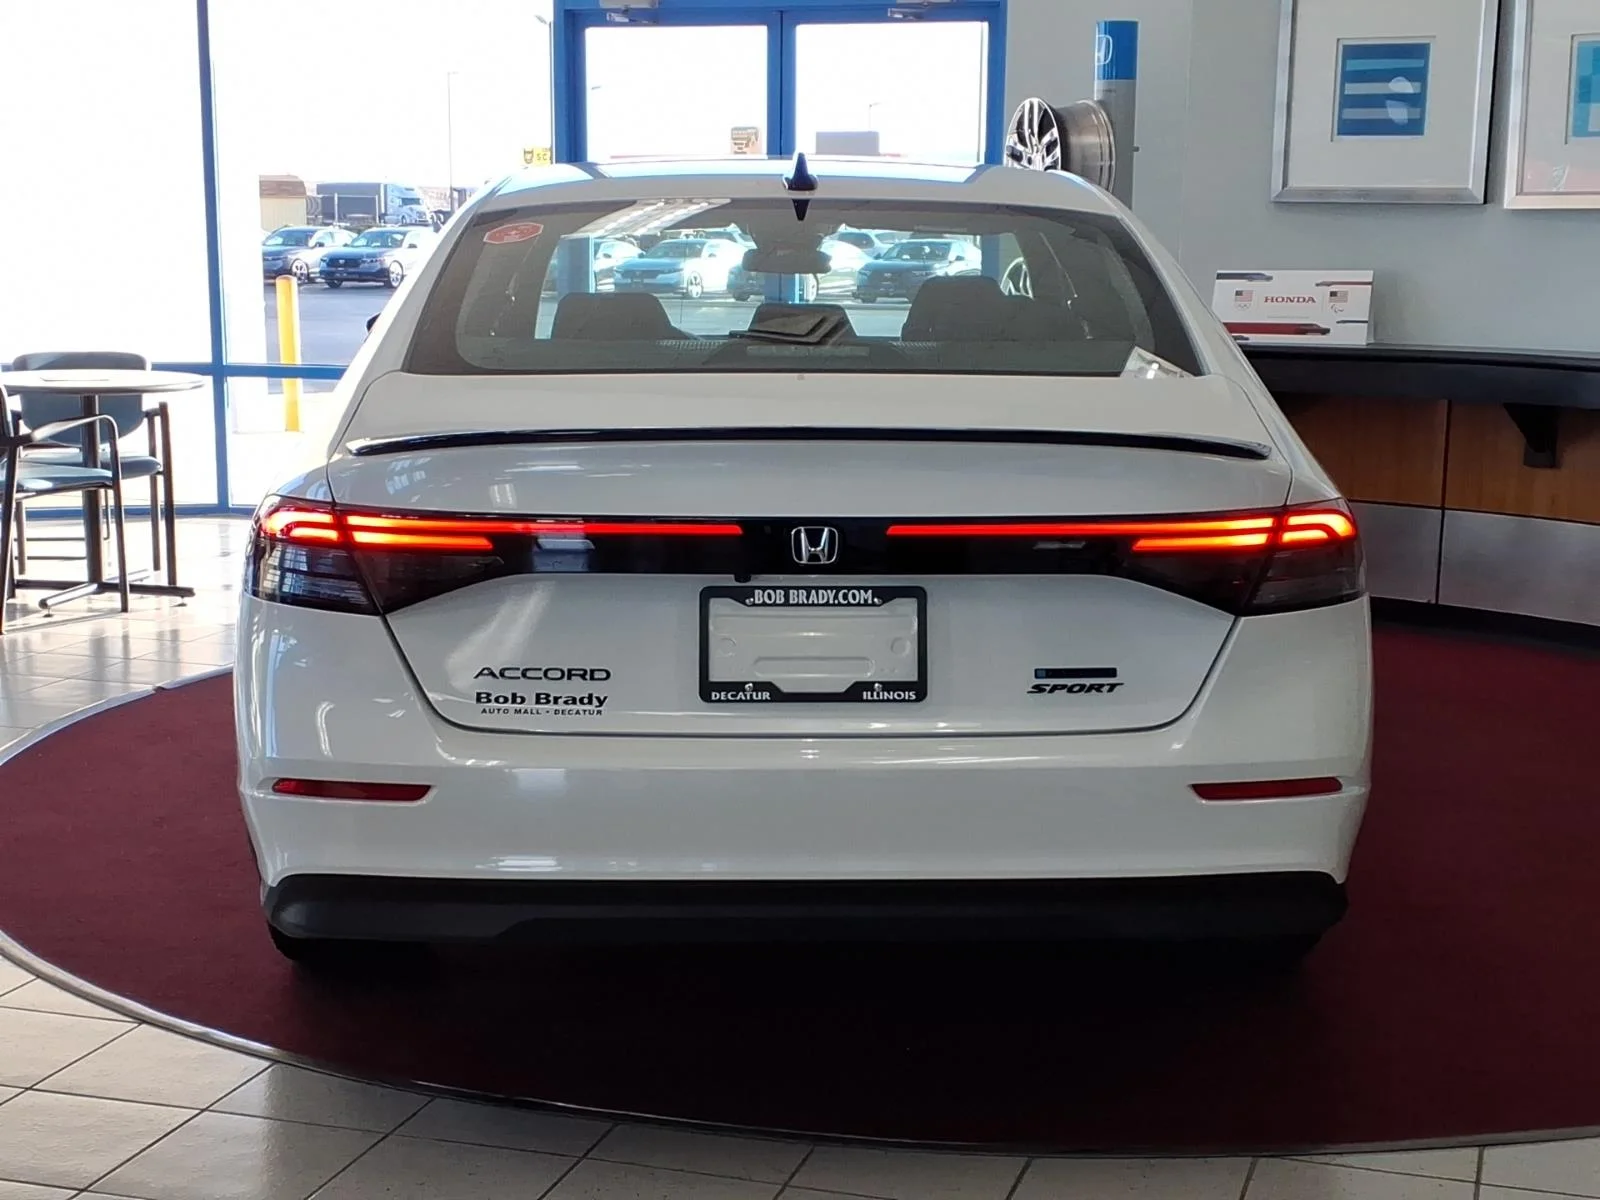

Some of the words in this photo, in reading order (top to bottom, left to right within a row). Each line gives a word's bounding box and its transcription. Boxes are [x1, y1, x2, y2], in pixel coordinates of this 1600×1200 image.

[1264, 296, 1316, 304] HONDA
[754, 589, 785, 604] BOB
[789, 589, 873, 604] BRADY.COM
[473, 667, 612, 681] ACCORD
[1026, 682, 1125, 694] SPORT
[475, 692, 527, 705] Bob
[534, 692, 609, 708] Brady
[711, 690, 772, 701] DECATUR
[862, 690, 917, 700] ILLINOIS
[554, 708, 603, 716] DECATUR
